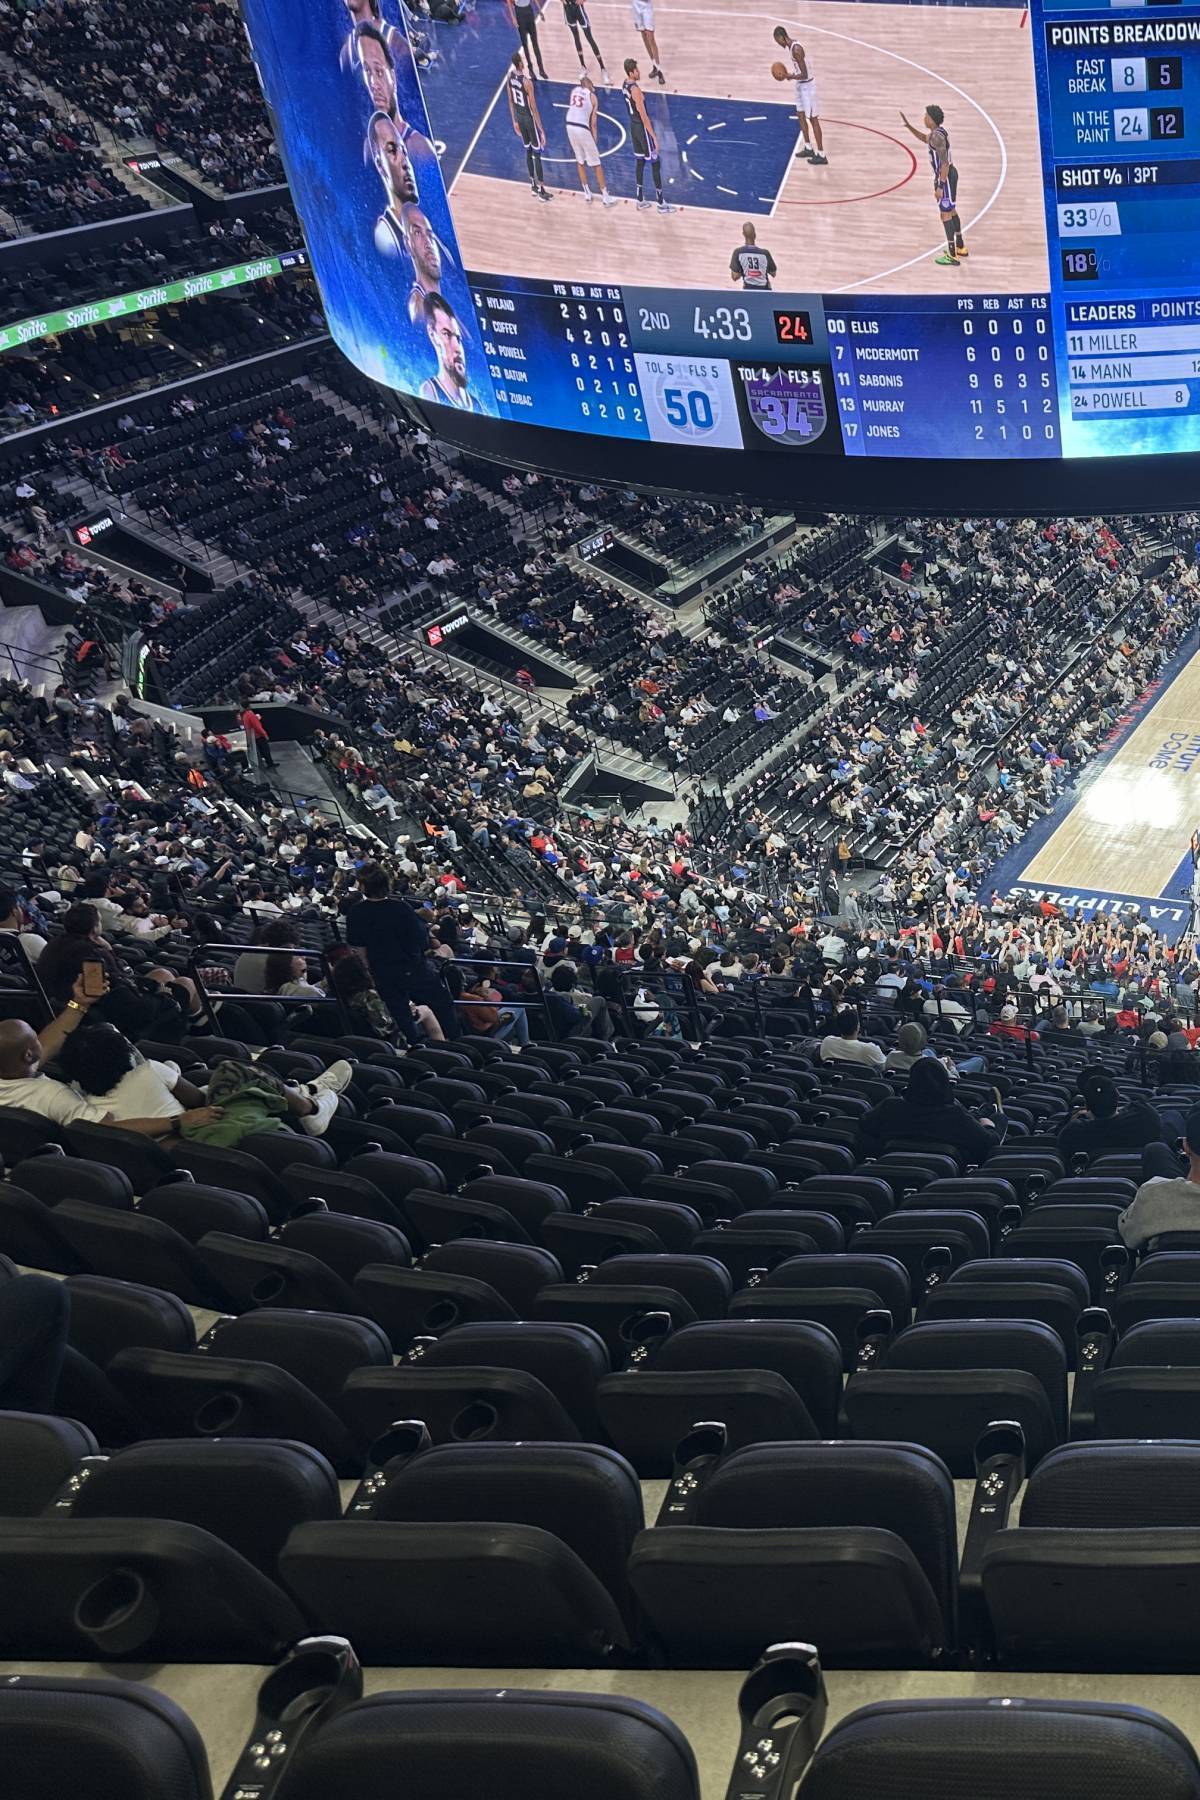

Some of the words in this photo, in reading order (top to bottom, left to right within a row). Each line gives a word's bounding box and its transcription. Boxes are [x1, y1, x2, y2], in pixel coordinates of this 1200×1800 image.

[1052, 26, 1110, 45] POINTS
[1076, 60, 1104, 75] FAST
[1124, 66, 1134, 86] 8
[1160, 65, 1171, 85] 5
[1069, 78, 1106, 93] BREAK
[1073, 112, 1085, 126] IN
[1088, 111, 1109, 125] THE
[1121, 117, 1142, 135] 24
[1157, 114, 1176, 134] 12
[1077, 129, 1110, 143] PAINT
[1062, 169, 1100, 186] SHOT
[1104, 167, 1122, 184] %
[1134, 167, 1158, 183] 3PT
[1064, 208, 1111, 227] 33%
[553, 284, 566, 295] PTS
[572, 286, 585, 297] REB
[590, 288, 602, 298] AST
[608, 288, 620, 299] FLS
[17, 319, 48, 342] Sprite
[67, 308, 100, 328] Sprite
[137, 288, 167, 310] Sprite
[184, 276, 212, 297] Sprite
[245, 260, 272, 280] Sprite
[474, 293, 482, 307] 5
[487, 297, 515, 311] HYLAND
[560, 303, 569, 318] 2
[579, 305, 587, 320] 3
[598, 307, 604, 321] 1
[614, 308, 622, 322] 0
[958, 300, 973, 310] PTS
[984, 300, 999, 310] REB
[1008, 299, 1023, 309] AST
[1032, 299, 1046, 308] FLS
[1071, 304, 1136, 321] LEADERS
[492, 321, 518, 335] COFFEY
[639, 308, 670, 331] 2ND
[694, 307, 752, 341] 4:33
[778, 316, 808, 340] 24
[828, 319, 845, 333] 00
[852, 321, 879, 334] ELLIS
[964, 320, 973, 334] 0
[989, 320, 997, 334] 0
[1014, 319, 1022, 334] 0
[1036, 319, 1045, 333] 0
[484, 342, 496, 355] 24
[498, 345, 526, 360] POWELL
[1071, 336, 1084, 351] 11
[1089, 334, 1137, 350] MILLER
[836, 347, 844, 359] 7
[856, 348, 919, 361] MCDERMOTT
[967, 347, 975, 362] 6
[992, 347, 1000, 361] 0
[1016, 347, 1025, 361] 0
[1039, 346, 1047, 360] 0
[490, 365, 501, 378] 33
[646, 362, 664, 374] TOL
[667, 363, 674, 376] 5
[689, 365, 707, 377] FLS
[711, 366, 719, 379] 5
[738, 367, 758, 381] TOL
[762, 368, 771, 382] 4
[788, 370, 808, 384] FLS
[813, 369, 821, 385] 5
[1072, 365, 1086, 380] 14
[1091, 364, 1132, 379] MANN
[838, 373, 850, 385] 11
[859, 375, 903, 387] SABONIS
[969, 374, 978, 388] 9
[994, 374, 1003, 388] 6
[1019, 374, 1027, 388] 3
[1041, 373, 1049, 387] 5
[751, 389, 819, 399] SACRAMENTO
[1074, 396, 1088, 407] 24
[1093, 392, 1147, 409] POWELL
[1175, 391, 1183, 403] 8
[664, 388, 714, 429] 50
[840, 399, 855, 411] 13
[863, 401, 904, 413] MURRAY
[970, 400, 982, 413] 11
[997, 400, 1005, 413] 5
[1021, 400, 1028, 413] 1
[1043, 399, 1052, 412] 2
[762, 397, 813, 436] 34
[845, 424, 858, 436] 17
[867, 426, 899, 437] JONES
[975, 426, 984, 439] 2
[1000, 426, 1006, 439] 1
[1023, 426, 1031, 439] 0
[1045, 425, 1053, 438] 0
[89, 518, 113, 535] TOYOTA
[441, 616, 468, 634] TOYOTA
[1150, 906, 1183, 921] LA
